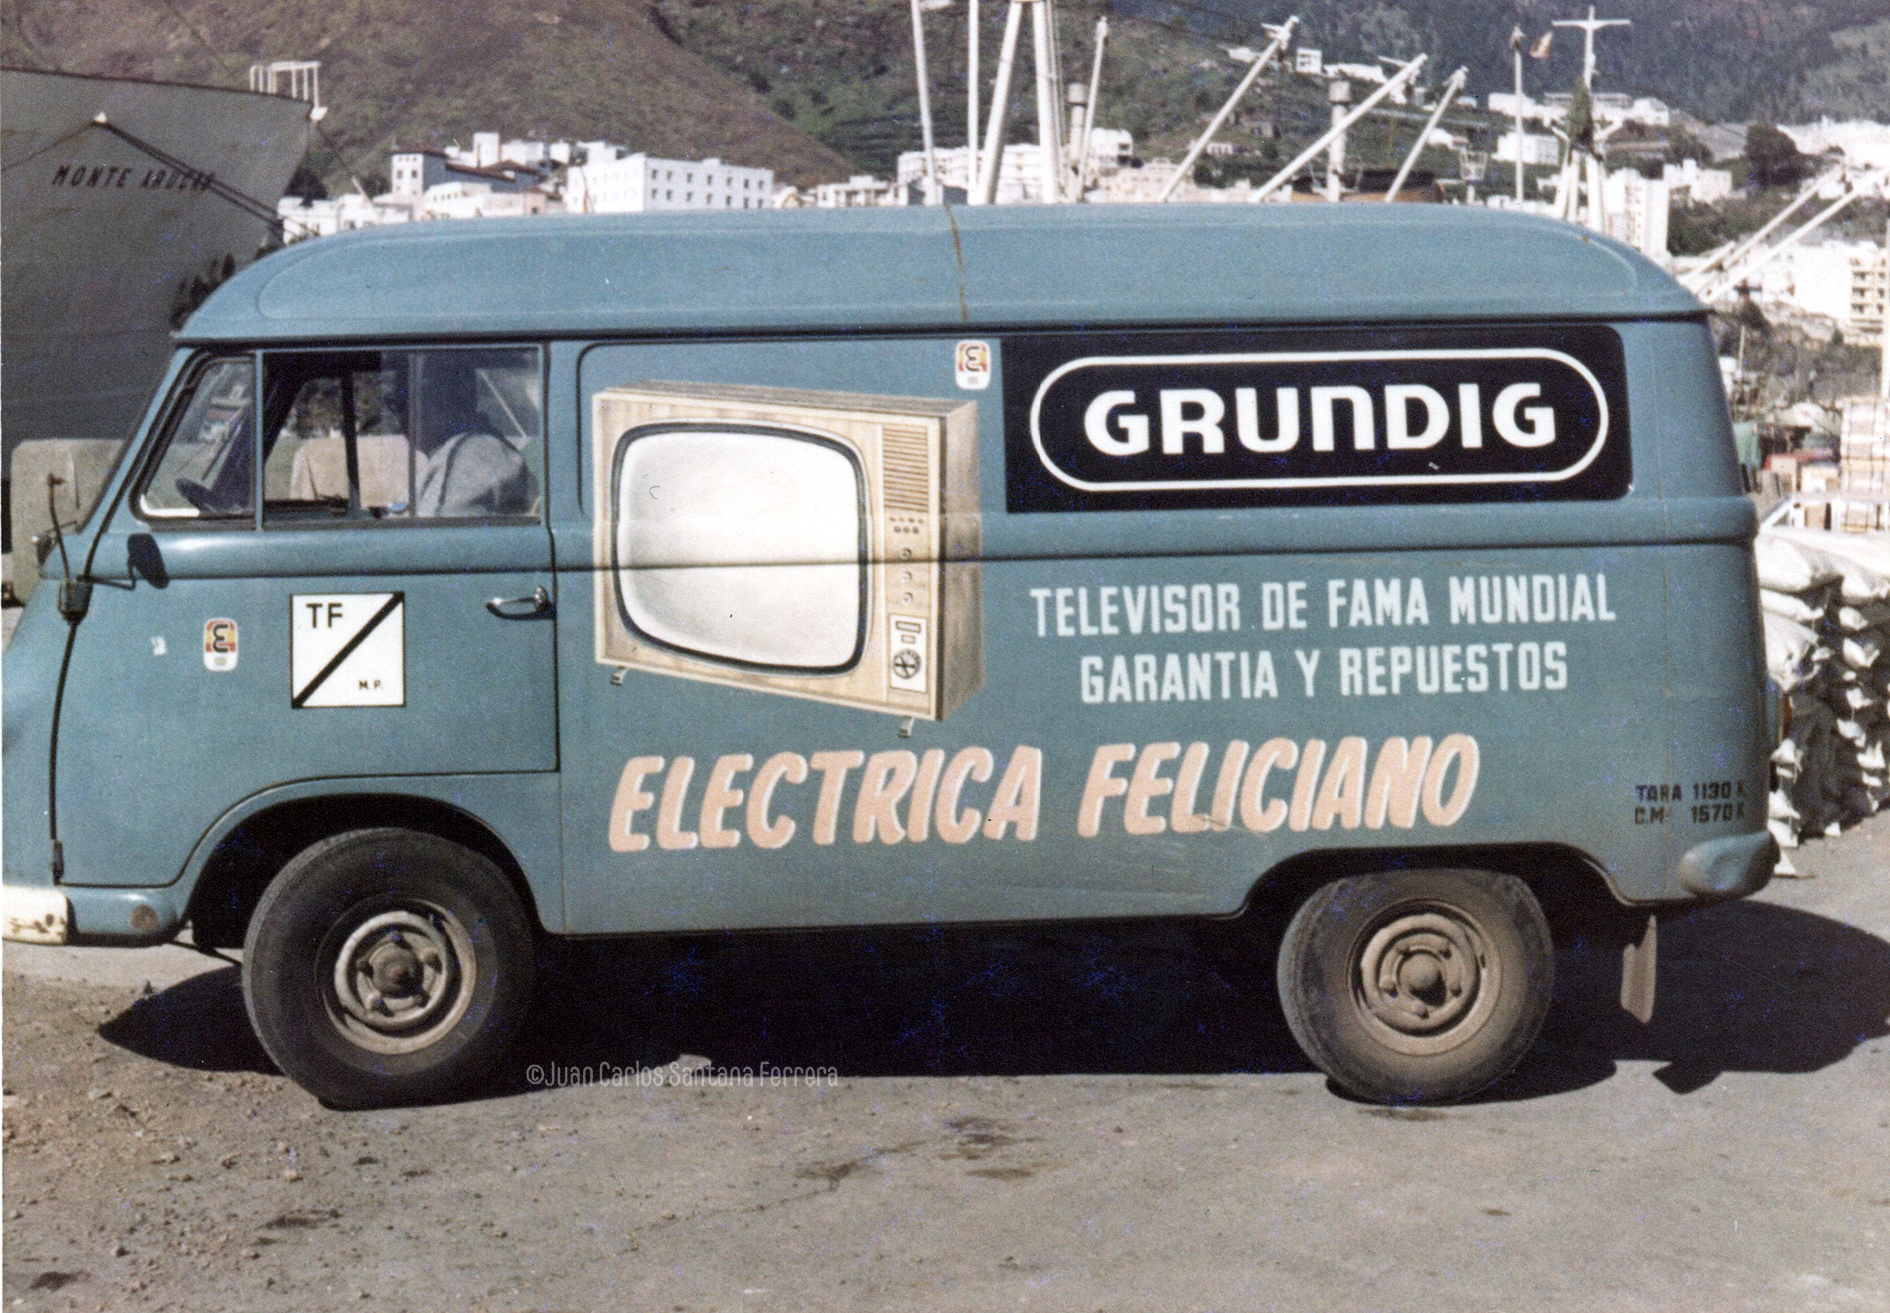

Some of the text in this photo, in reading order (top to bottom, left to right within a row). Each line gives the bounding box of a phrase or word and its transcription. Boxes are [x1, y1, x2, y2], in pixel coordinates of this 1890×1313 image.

[51, 164, 133, 188] MONTE
[1084, 383, 1556, 456] GRUNDIG
[306, 603, 343, 629] TF
[1030, 574, 1617, 637] TELEVISOR DE FAMA MUNDIAL
[1080, 642, 1569, 704] GARANTIA Y REPUESTOS
[608, 733, 1480, 852] ELECTRICA FELICIANO
[1635, 784, 1682, 801] TARA
[1693, 781, 1731, 800] 1130
[1691, 803, 1733, 823] 1570
